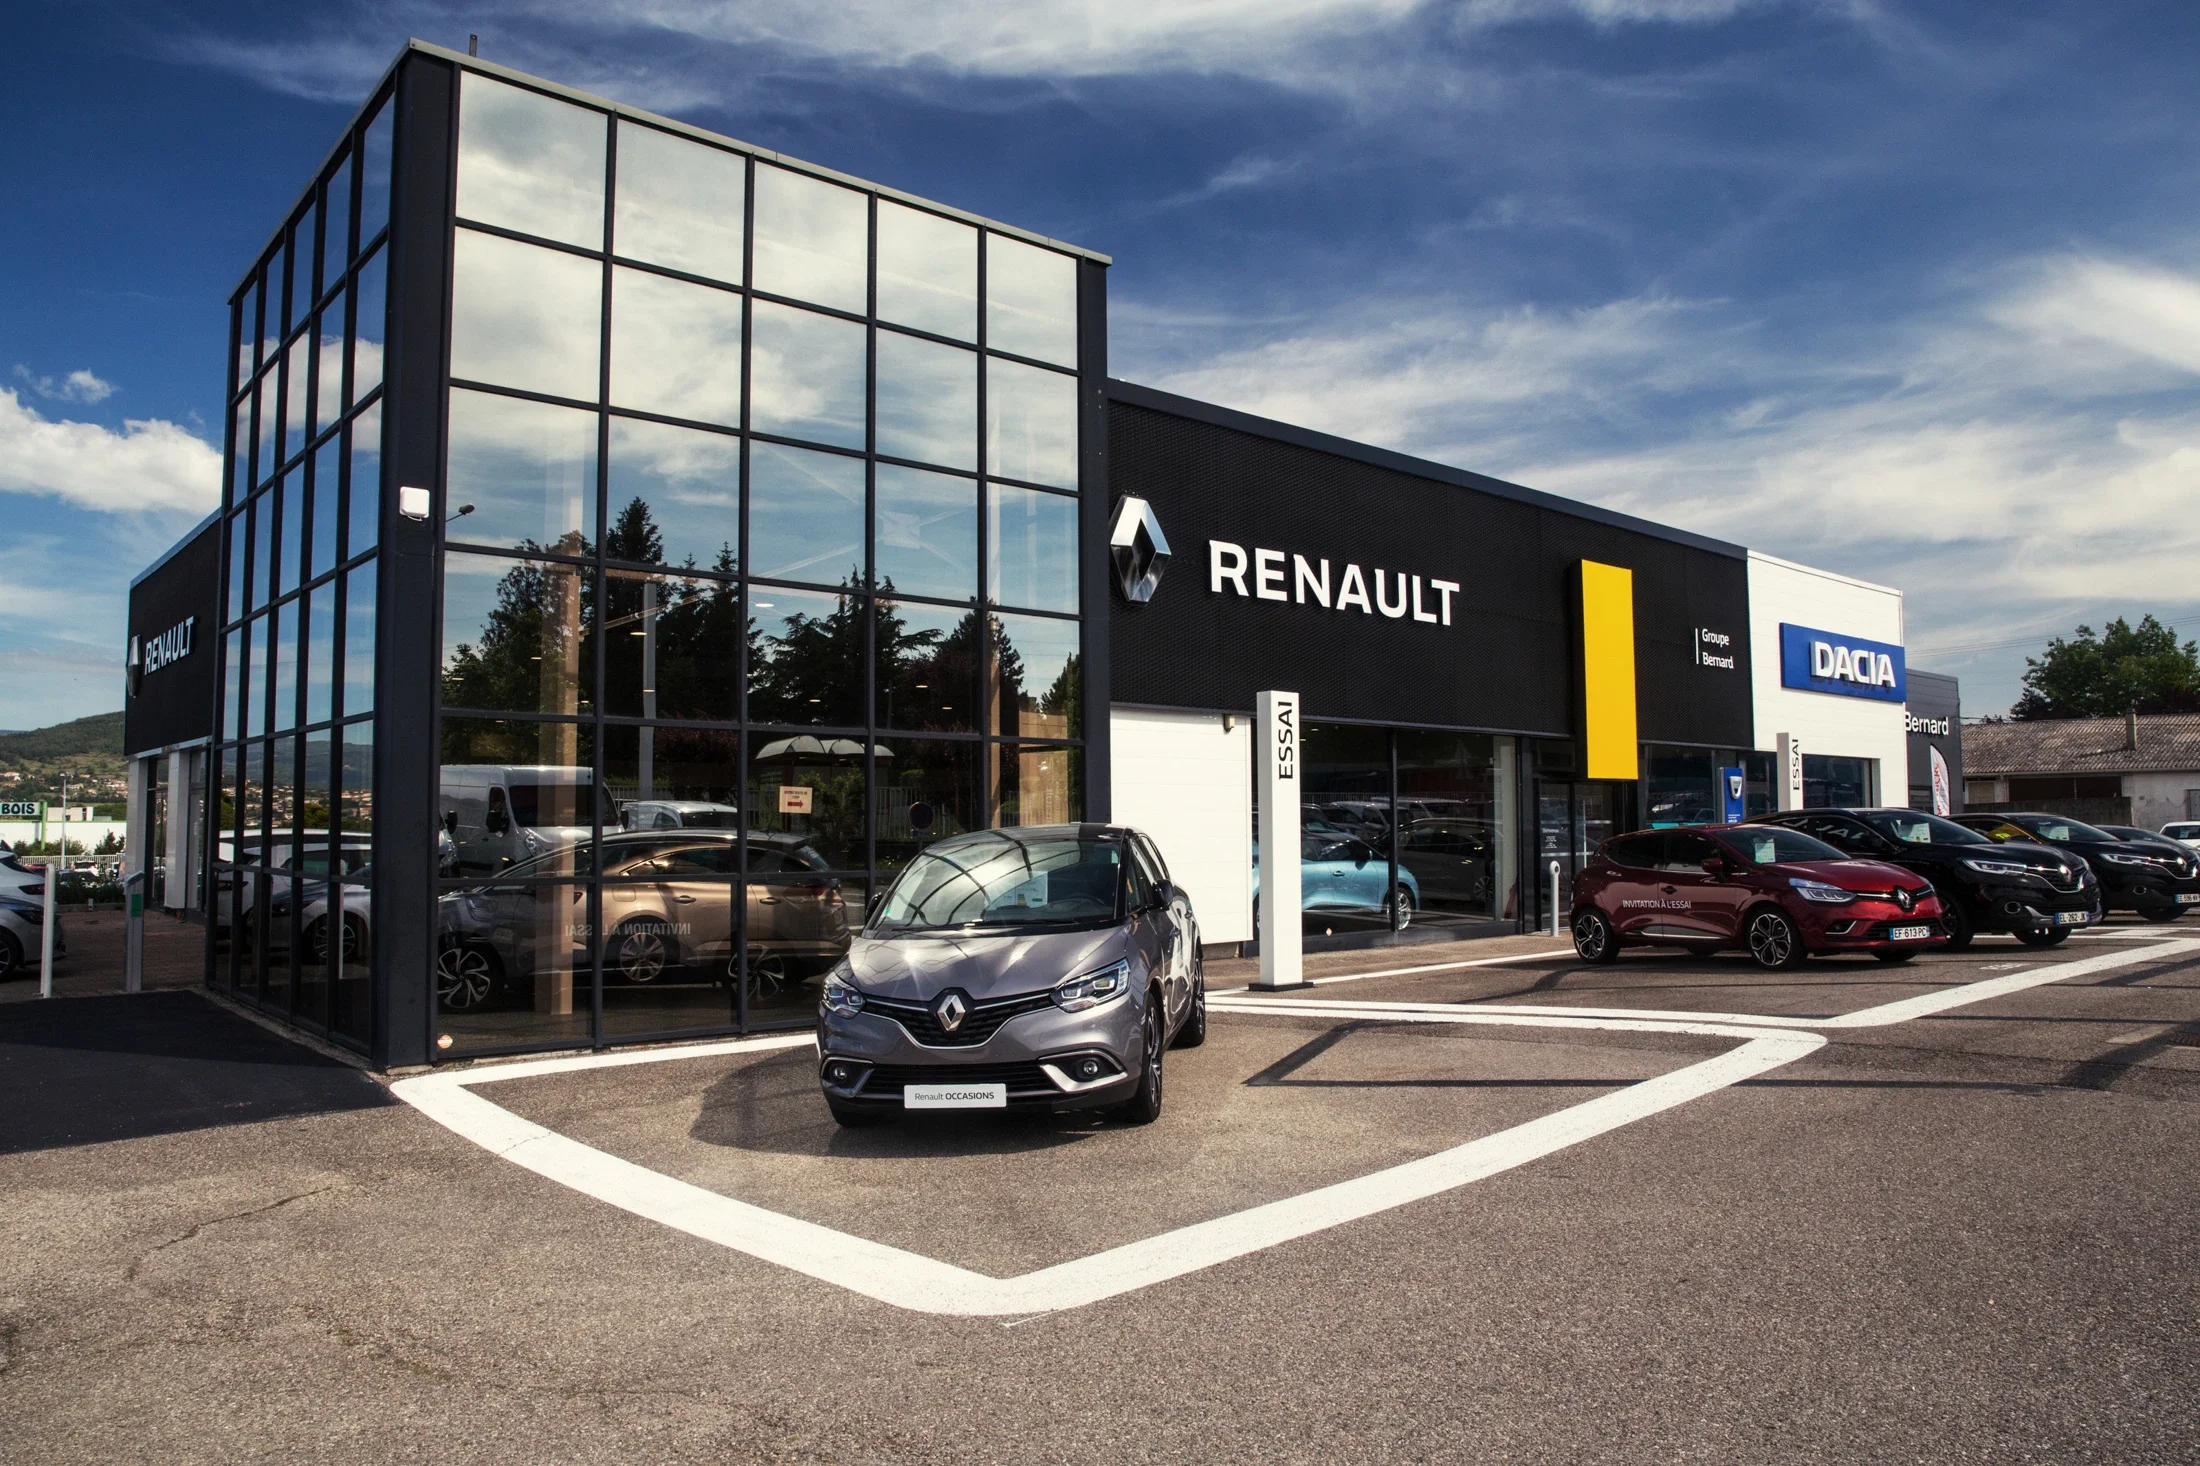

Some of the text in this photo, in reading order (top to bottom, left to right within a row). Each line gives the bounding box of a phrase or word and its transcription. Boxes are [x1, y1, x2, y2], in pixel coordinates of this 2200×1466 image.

[1208, 539, 1460, 626] RENAULT
[144, 615, 194, 676] RENAULT
[1702, 628, 1730, 648] Groupe
[1702, 651, 1734, 669] Bernard
[1810, 640, 1897, 688] DACIA
[1904, 711, 1949, 736] Bernard
[1277, 701, 1294, 781] ESSAI
[1791, 738, 1800, 791] ESSAI
[1, 803, 35, 815] BOIS
[1622, 898, 1692, 909] INVITATION À L'ESSAI
[1894, 927, 1927, 939] EF-613-PC
[914, 1091, 995, 1101] Renault OCCASIONS
